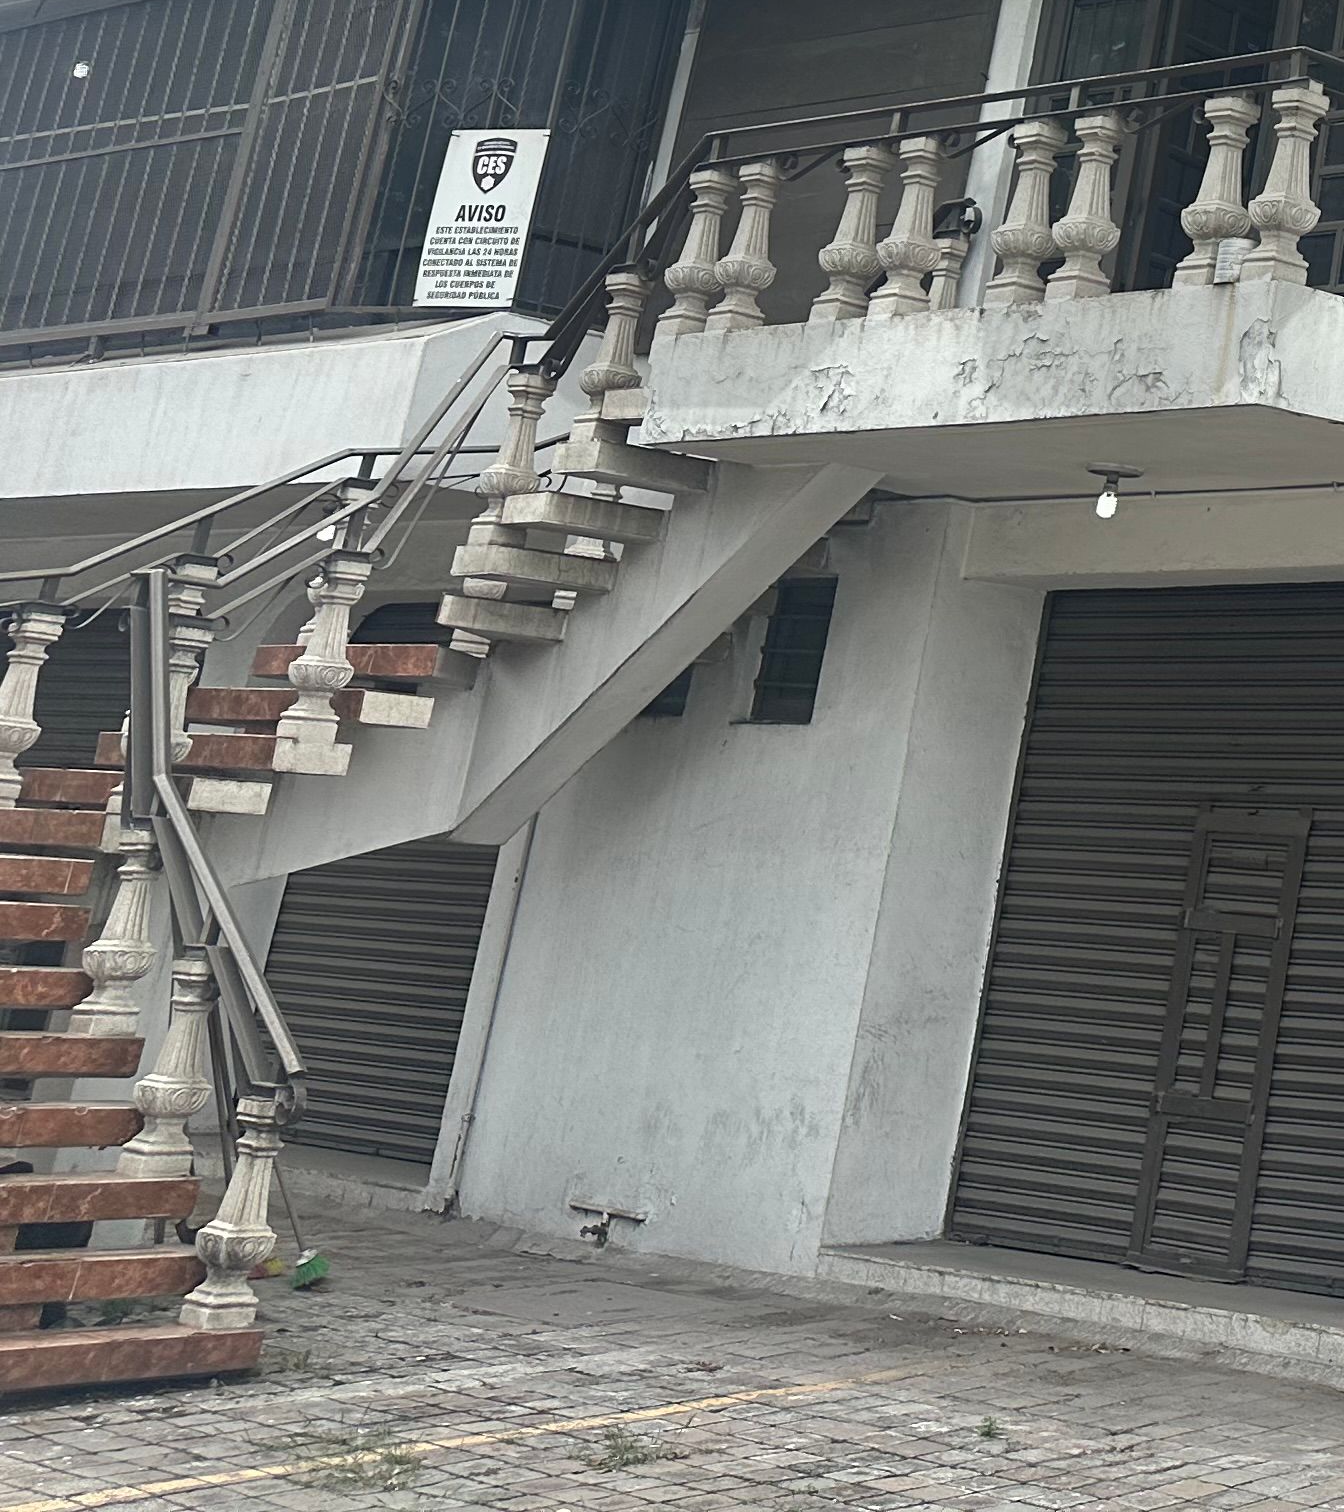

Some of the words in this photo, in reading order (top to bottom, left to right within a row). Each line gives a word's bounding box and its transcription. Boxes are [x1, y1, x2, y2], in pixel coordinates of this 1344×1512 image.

[476, 155, 507, 175] CES
[455, 204, 506, 223] AVISO
[435, 226, 453, 234] ESTE
[454, 226, 519, 234] ESTABLECIMIENTO
[429, 237, 456, 245] CUENTA
[458, 237, 473, 245] CON
[474, 237, 509, 245] CIRCUITO
[510, 237, 520, 245] DE
[427, 248, 466, 256] VIGILANCIA
[467, 248, 482, 256] LAS
[482, 248, 492, 256] 24
[493, 248, 519, 256] HORAS
[422, 258, 463, 267] CONECTADO
[464, 258, 474, 267] AL
[475, 258, 507, 267] SISTEMA
[508, 258, 519, 267] DE
[422, 269, 461, 278] RESPUESTA
[463, 269, 503, 278] INMEDIATA
[504, 269, 514, 278] DE
[434, 280, 448, 288] LOS
[449, 280, 484, 288] CUERPOS
[485, 280, 496, 288] DE
[426, 291, 467, 299] SEGURIDAD
